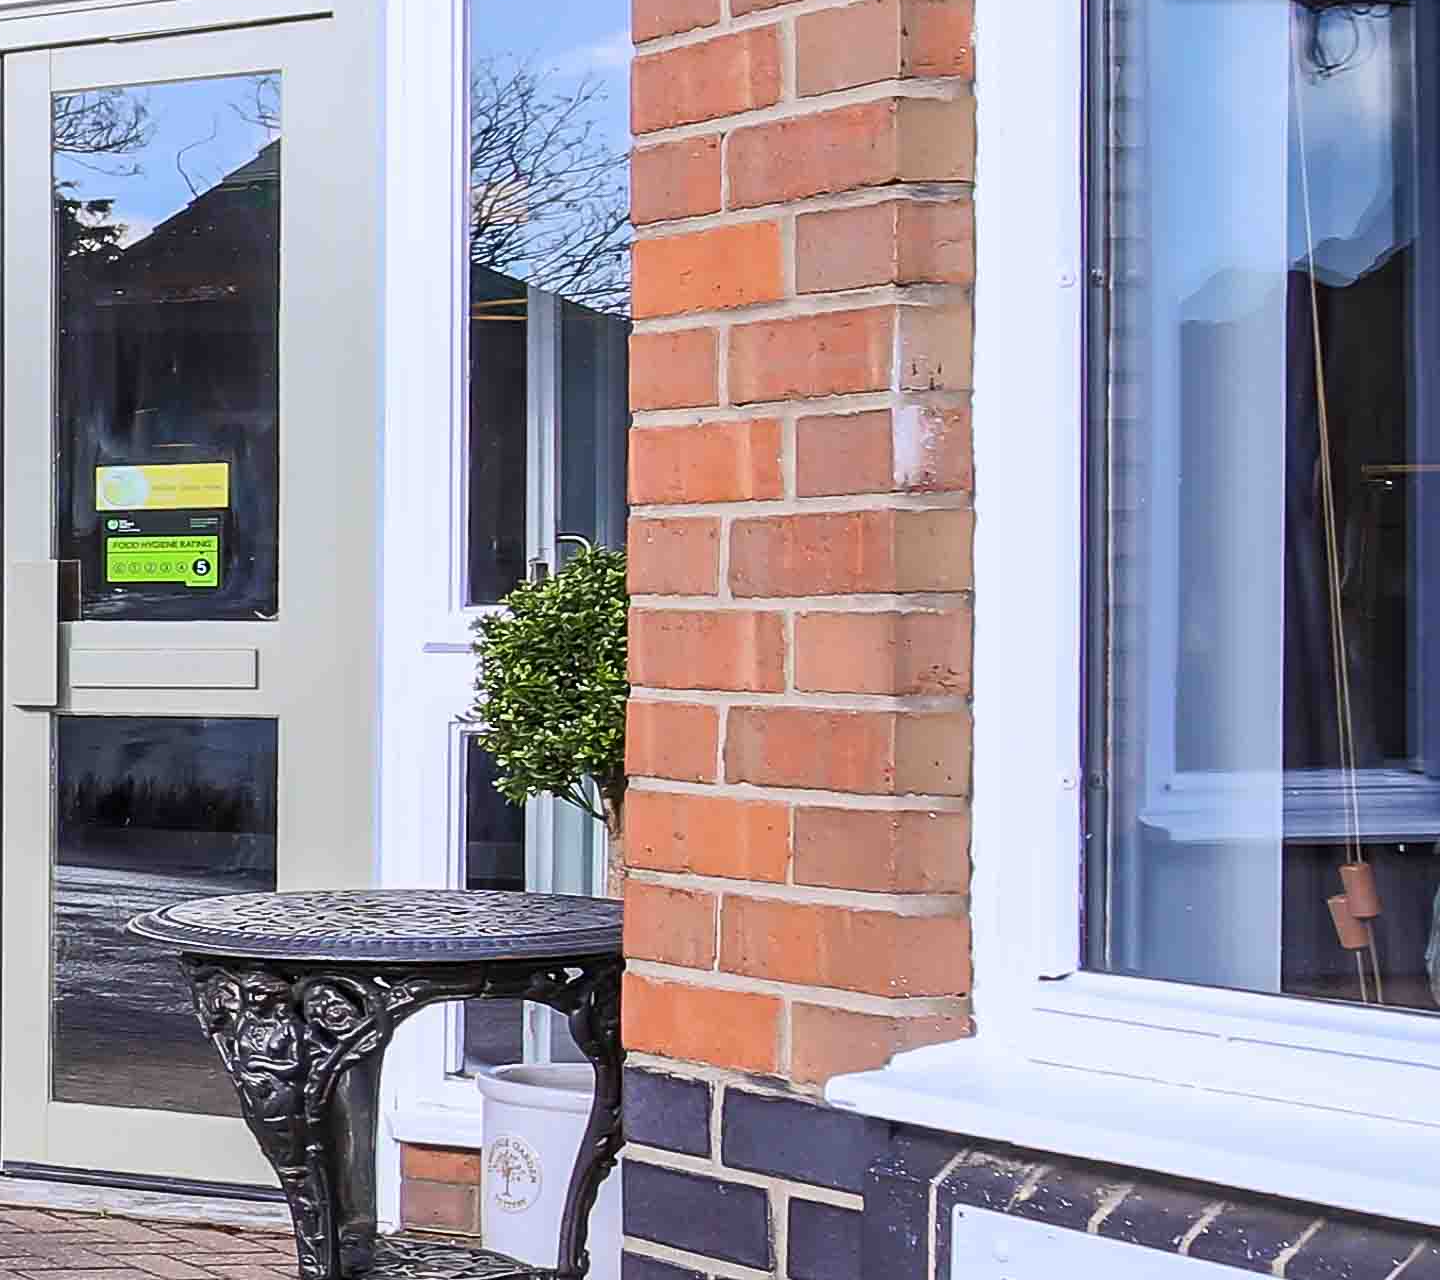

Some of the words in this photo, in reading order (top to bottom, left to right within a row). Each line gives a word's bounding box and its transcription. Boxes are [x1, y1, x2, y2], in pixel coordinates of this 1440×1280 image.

[112, 541, 139, 550] FOOD
[140, 540, 178, 549] HYGIENE
[180, 539, 212, 549] RATING
[196, 560, 208, 574] 5
